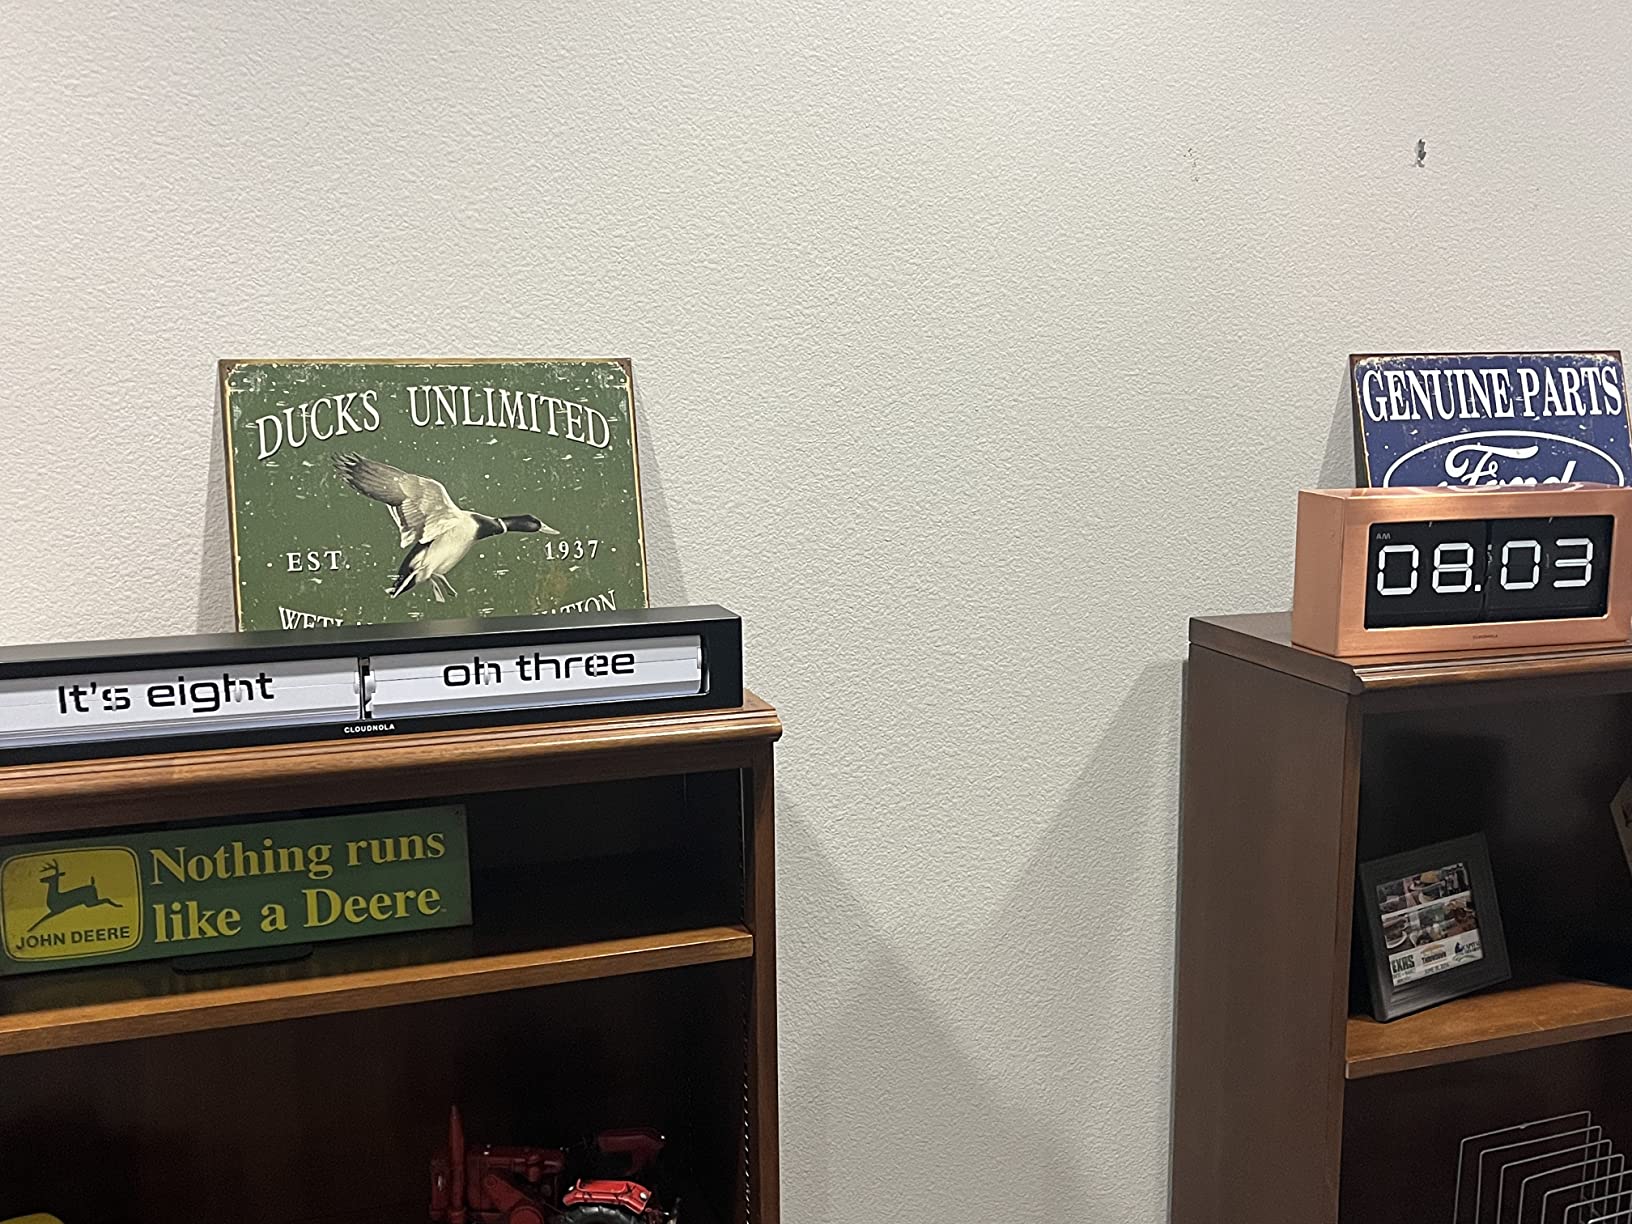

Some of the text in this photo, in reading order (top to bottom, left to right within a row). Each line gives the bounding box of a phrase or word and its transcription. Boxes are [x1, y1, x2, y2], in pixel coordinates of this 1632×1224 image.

[1363, 365, 1622, 421] GENUINE PARTS
[256, 385, 612, 460] DUCKS UNLIMITED
[545, 540, 599, 561] 1937
[1376, 532, 1391, 540] AM
[286, 551, 351, 572] EST.
[58, 652, 636, 714] It's eight oh three
[343, 723, 396, 735] CLOUDNOLA
[148, 831, 446, 885] Nothing runs
[153, 886, 442, 944] like a Deere
[16, 926, 131, 951] JOHN DEERE
